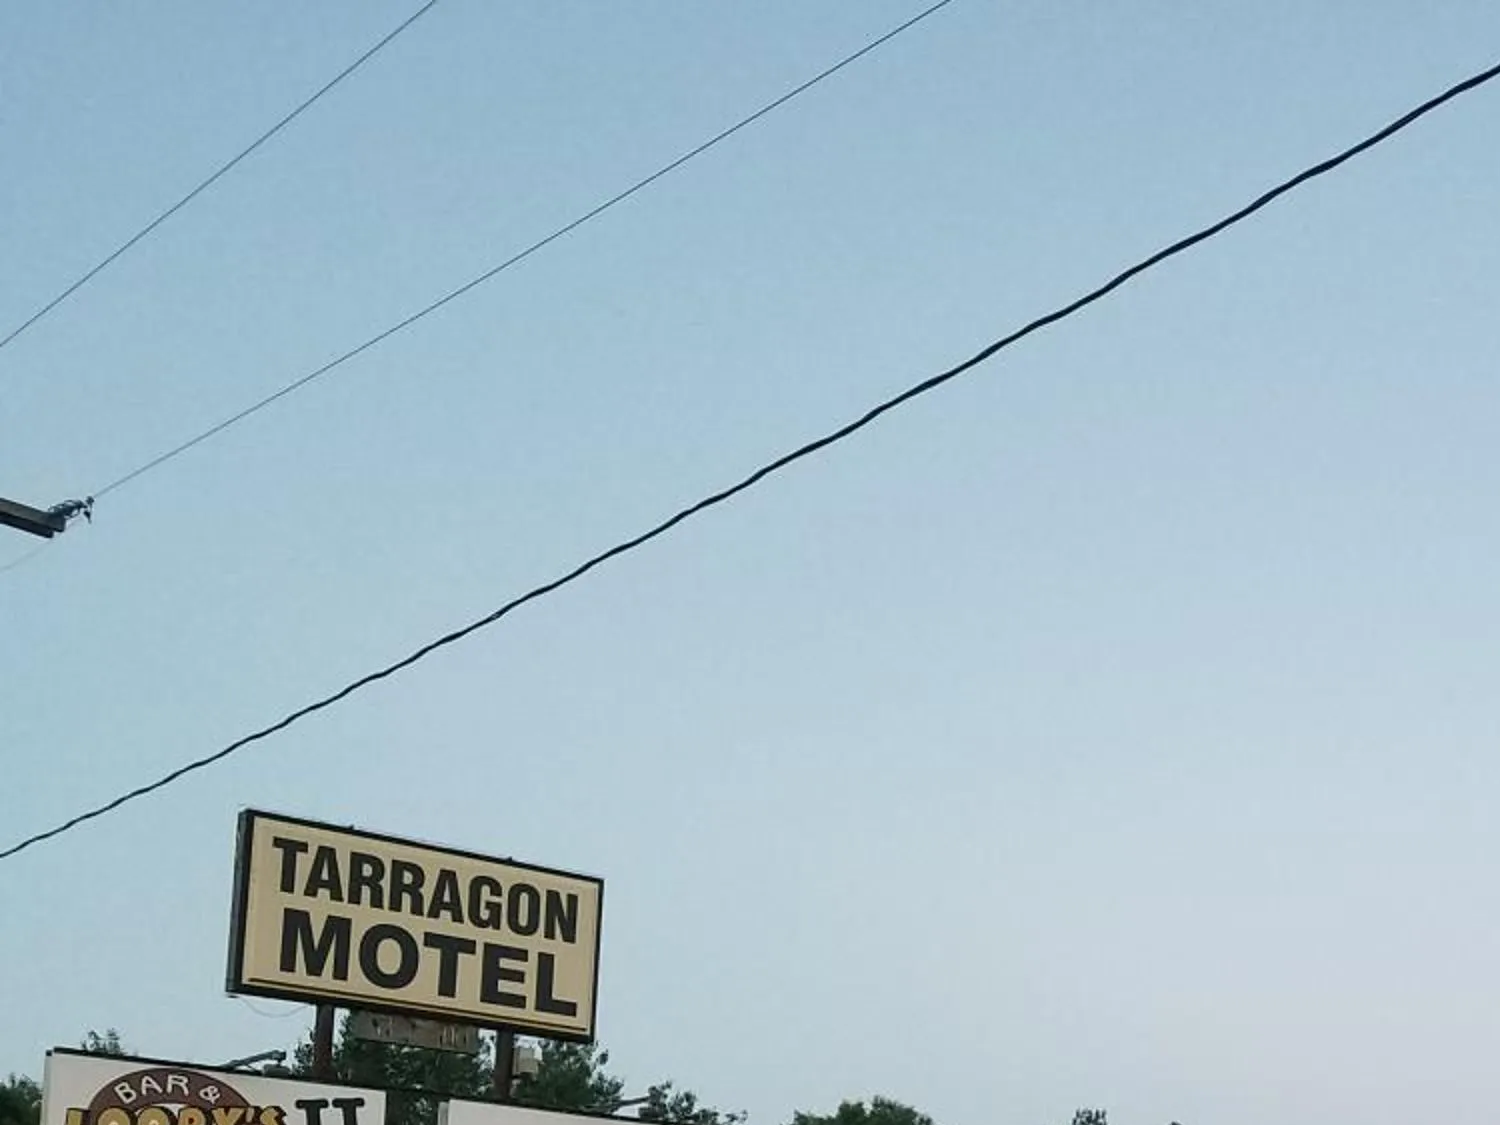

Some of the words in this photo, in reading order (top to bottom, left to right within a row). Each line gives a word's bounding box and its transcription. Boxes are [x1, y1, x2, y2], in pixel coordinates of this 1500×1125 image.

[272, 836, 579, 943] TARRAGON
[279, 908, 578, 1018] MOTEL
[114, 1073, 190, 1105] BAR
[199, 1085, 221, 1105] &
